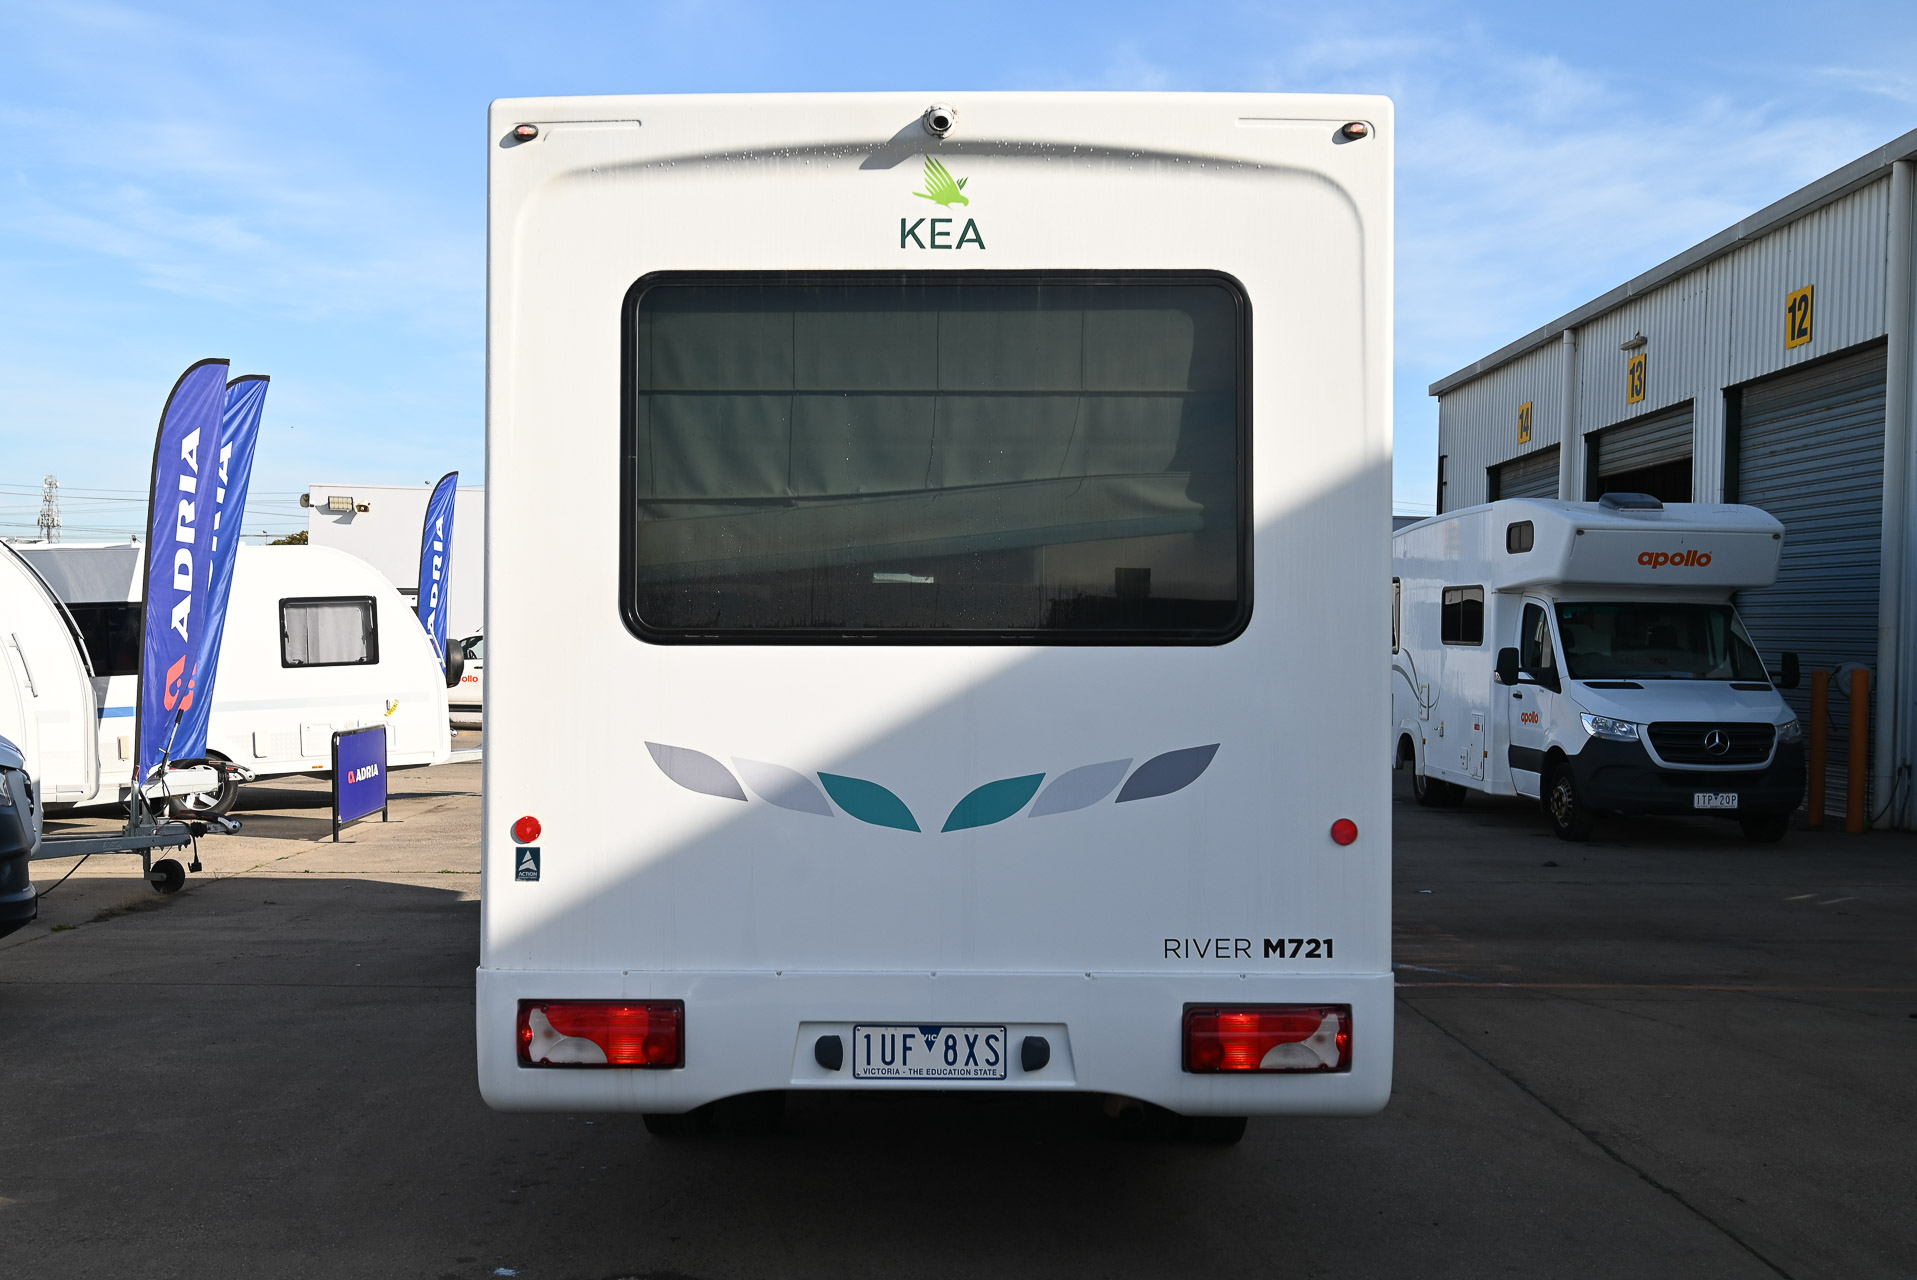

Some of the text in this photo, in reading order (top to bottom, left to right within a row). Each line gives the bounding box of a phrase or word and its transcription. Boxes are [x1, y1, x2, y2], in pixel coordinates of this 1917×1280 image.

[900, 217, 986, 250] KEA
[1787, 294, 1809, 342] 12
[1629, 360, 1643, 399] 13
[1518, 406, 1530, 438] 14
[171, 426, 201, 644] ADRIA
[427, 515, 444, 634] ADRIA
[1637, 549, 1712, 570] apollo
[459, 675, 479, 683] ollo
[1520, 711, 1539, 725] apollo
[356, 763, 379, 783] ADRIA
[1164, 938, 1333, 959] RIVER M721
[863, 1033, 1000, 1067] 1UF 8XS
[863, 1067, 900, 1075] VICTORIA
[908, 1068, 924, 1076] THE
[926, 1068, 971, 1076] EDUCATION
[973, 1068, 997, 1076] STATE
